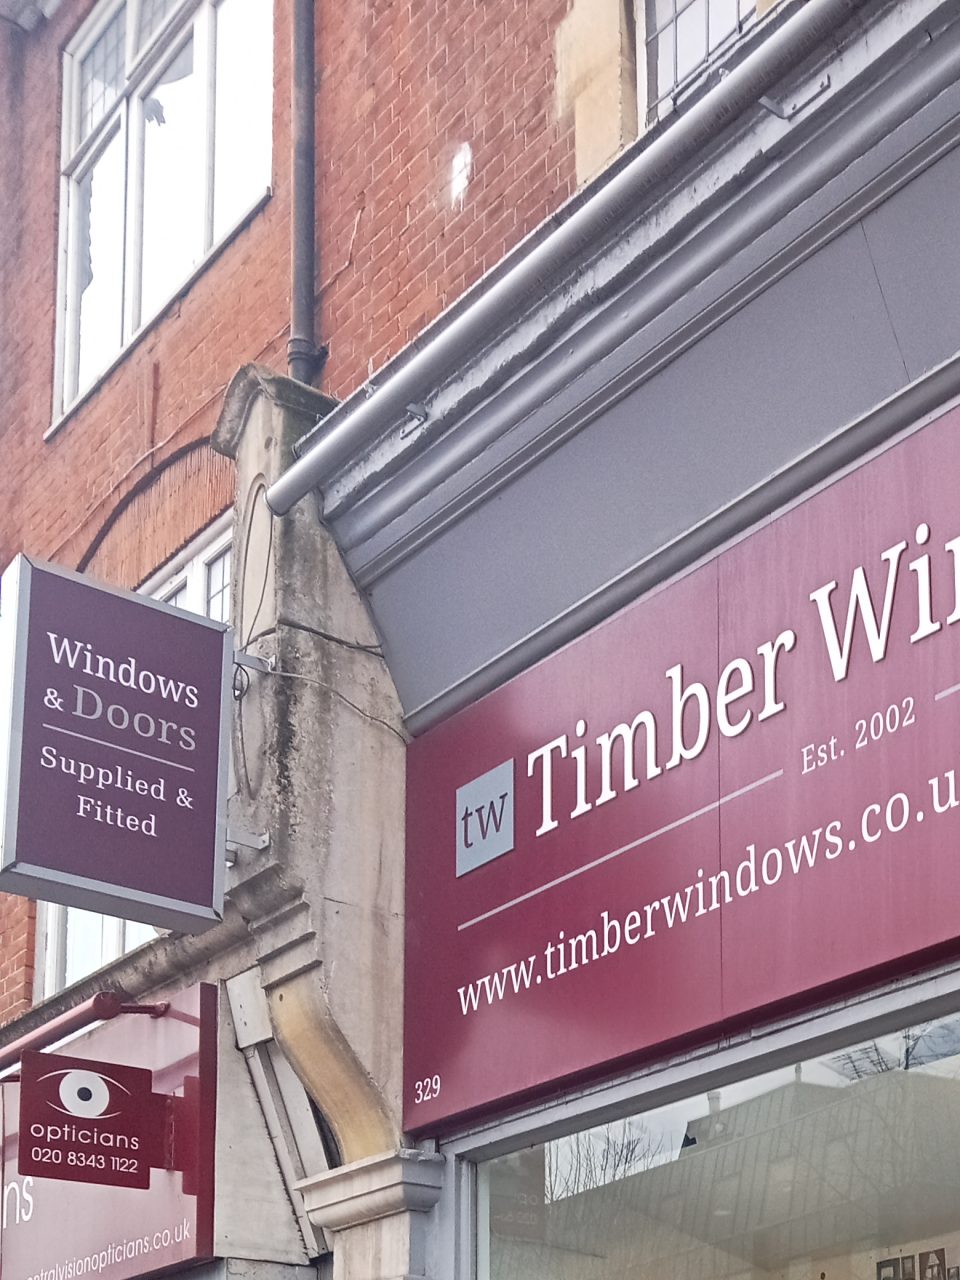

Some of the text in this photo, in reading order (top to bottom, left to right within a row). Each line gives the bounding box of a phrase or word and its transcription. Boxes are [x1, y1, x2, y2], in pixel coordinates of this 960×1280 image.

[47, 631, 199, 708] Windows
[43, 684, 197, 752] & Doors
[526, 629, 797, 838] Timber
[800, 696, 916, 775] Est. 2002
[40, 746, 194, 809] Supplied &
[76, 794, 158, 837] Fitted
[461, 792, 508, 849] tw
[414, 1074, 441, 1104] 329
[30, 1124, 139, 1150] opticians
[31, 1147, 138, 1173] 020 8343 1122
